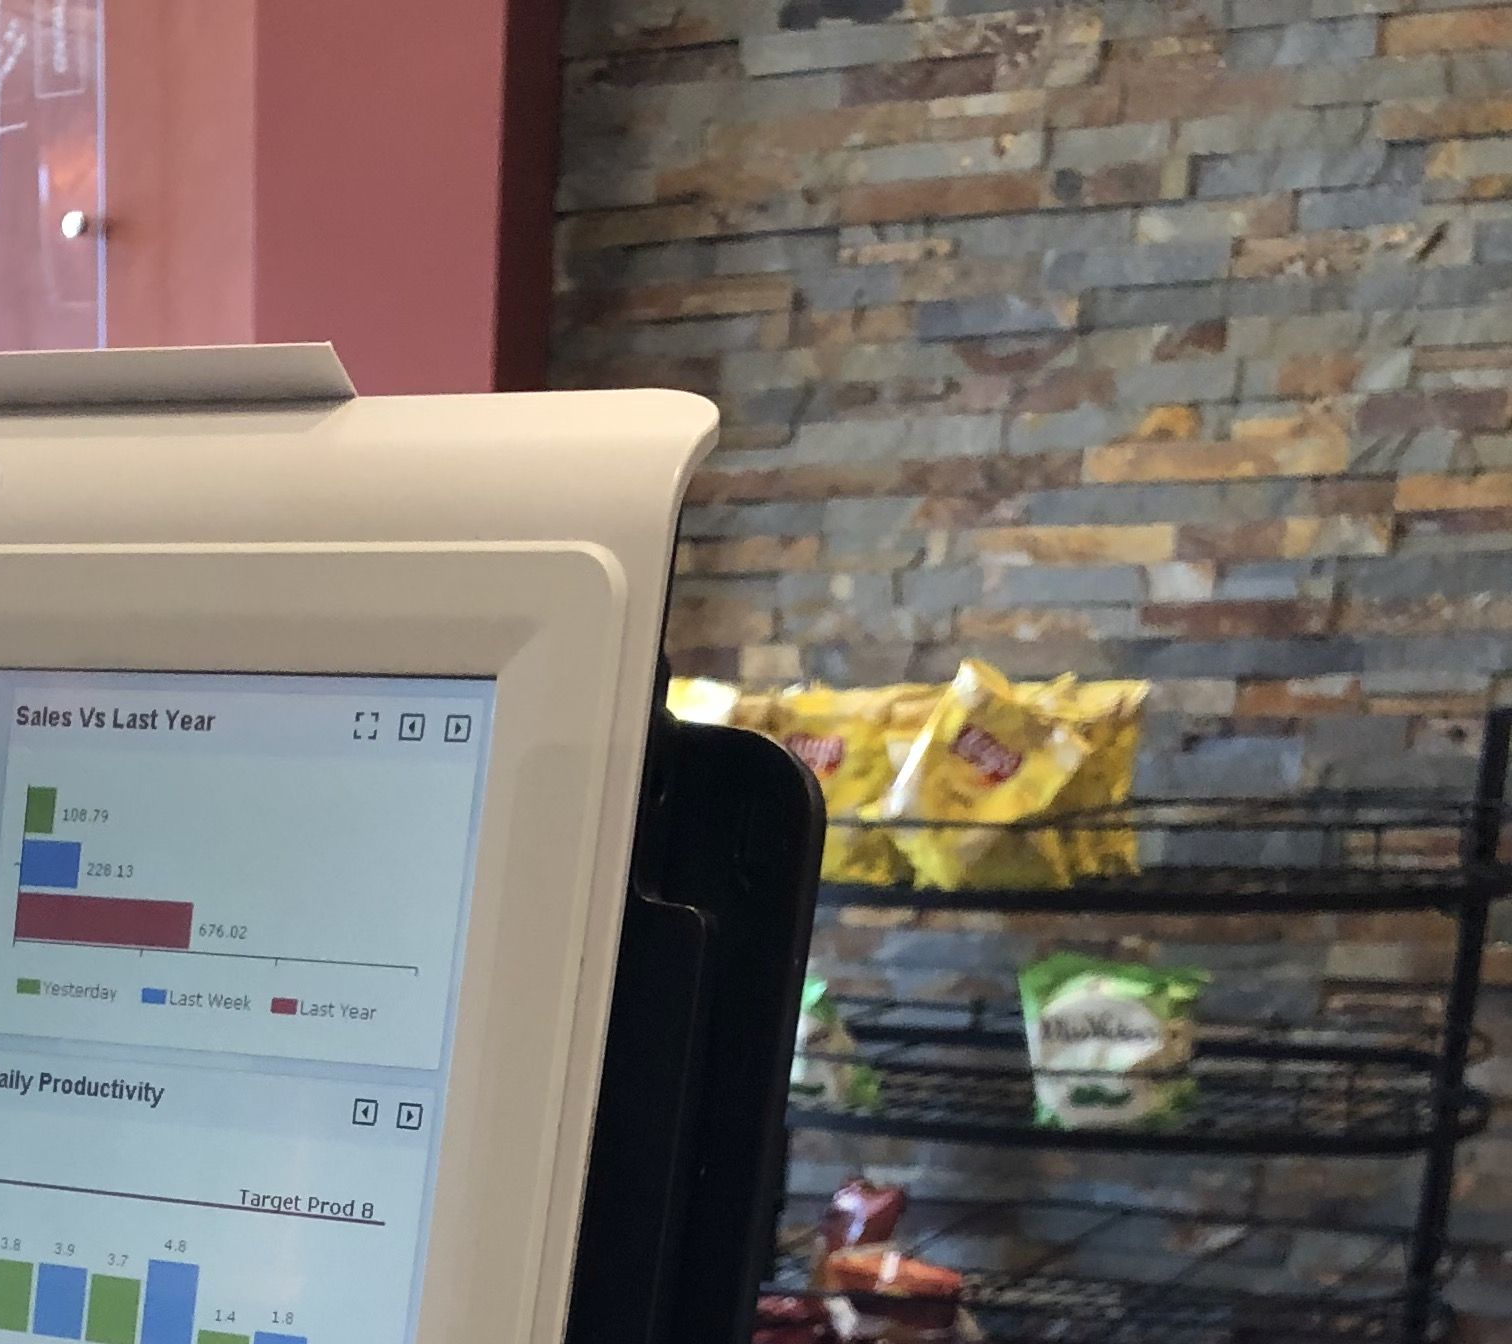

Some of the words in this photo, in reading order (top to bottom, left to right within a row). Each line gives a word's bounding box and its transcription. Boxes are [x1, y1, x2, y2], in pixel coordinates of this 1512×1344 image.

[16, 705, 73, 728] Sales
[79, 707, 106, 730] Vs
[112, 708, 158, 731] Last
[165, 710, 216, 733] Year
[62, 808, 109, 824] 108.79
[86, 861, 134, 878] 228.13
[199, 922, 248, 940] 676.02
[44, 980, 117, 1002] Yesterday
[170, 990, 202, 1008] Last
[208, 993, 252, 1011] Week
[300, 1000, 335, 1017] Last
[339, 1003, 377, 1021] Year
[38, 1072, 165, 1109] Productivity
[240, 1189, 301, 1213] Target
[308, 1195, 355, 1216] Prod
[163, 1239, 187, 1253] 4.8
[271, 1310, 294, 1326] 1.8
